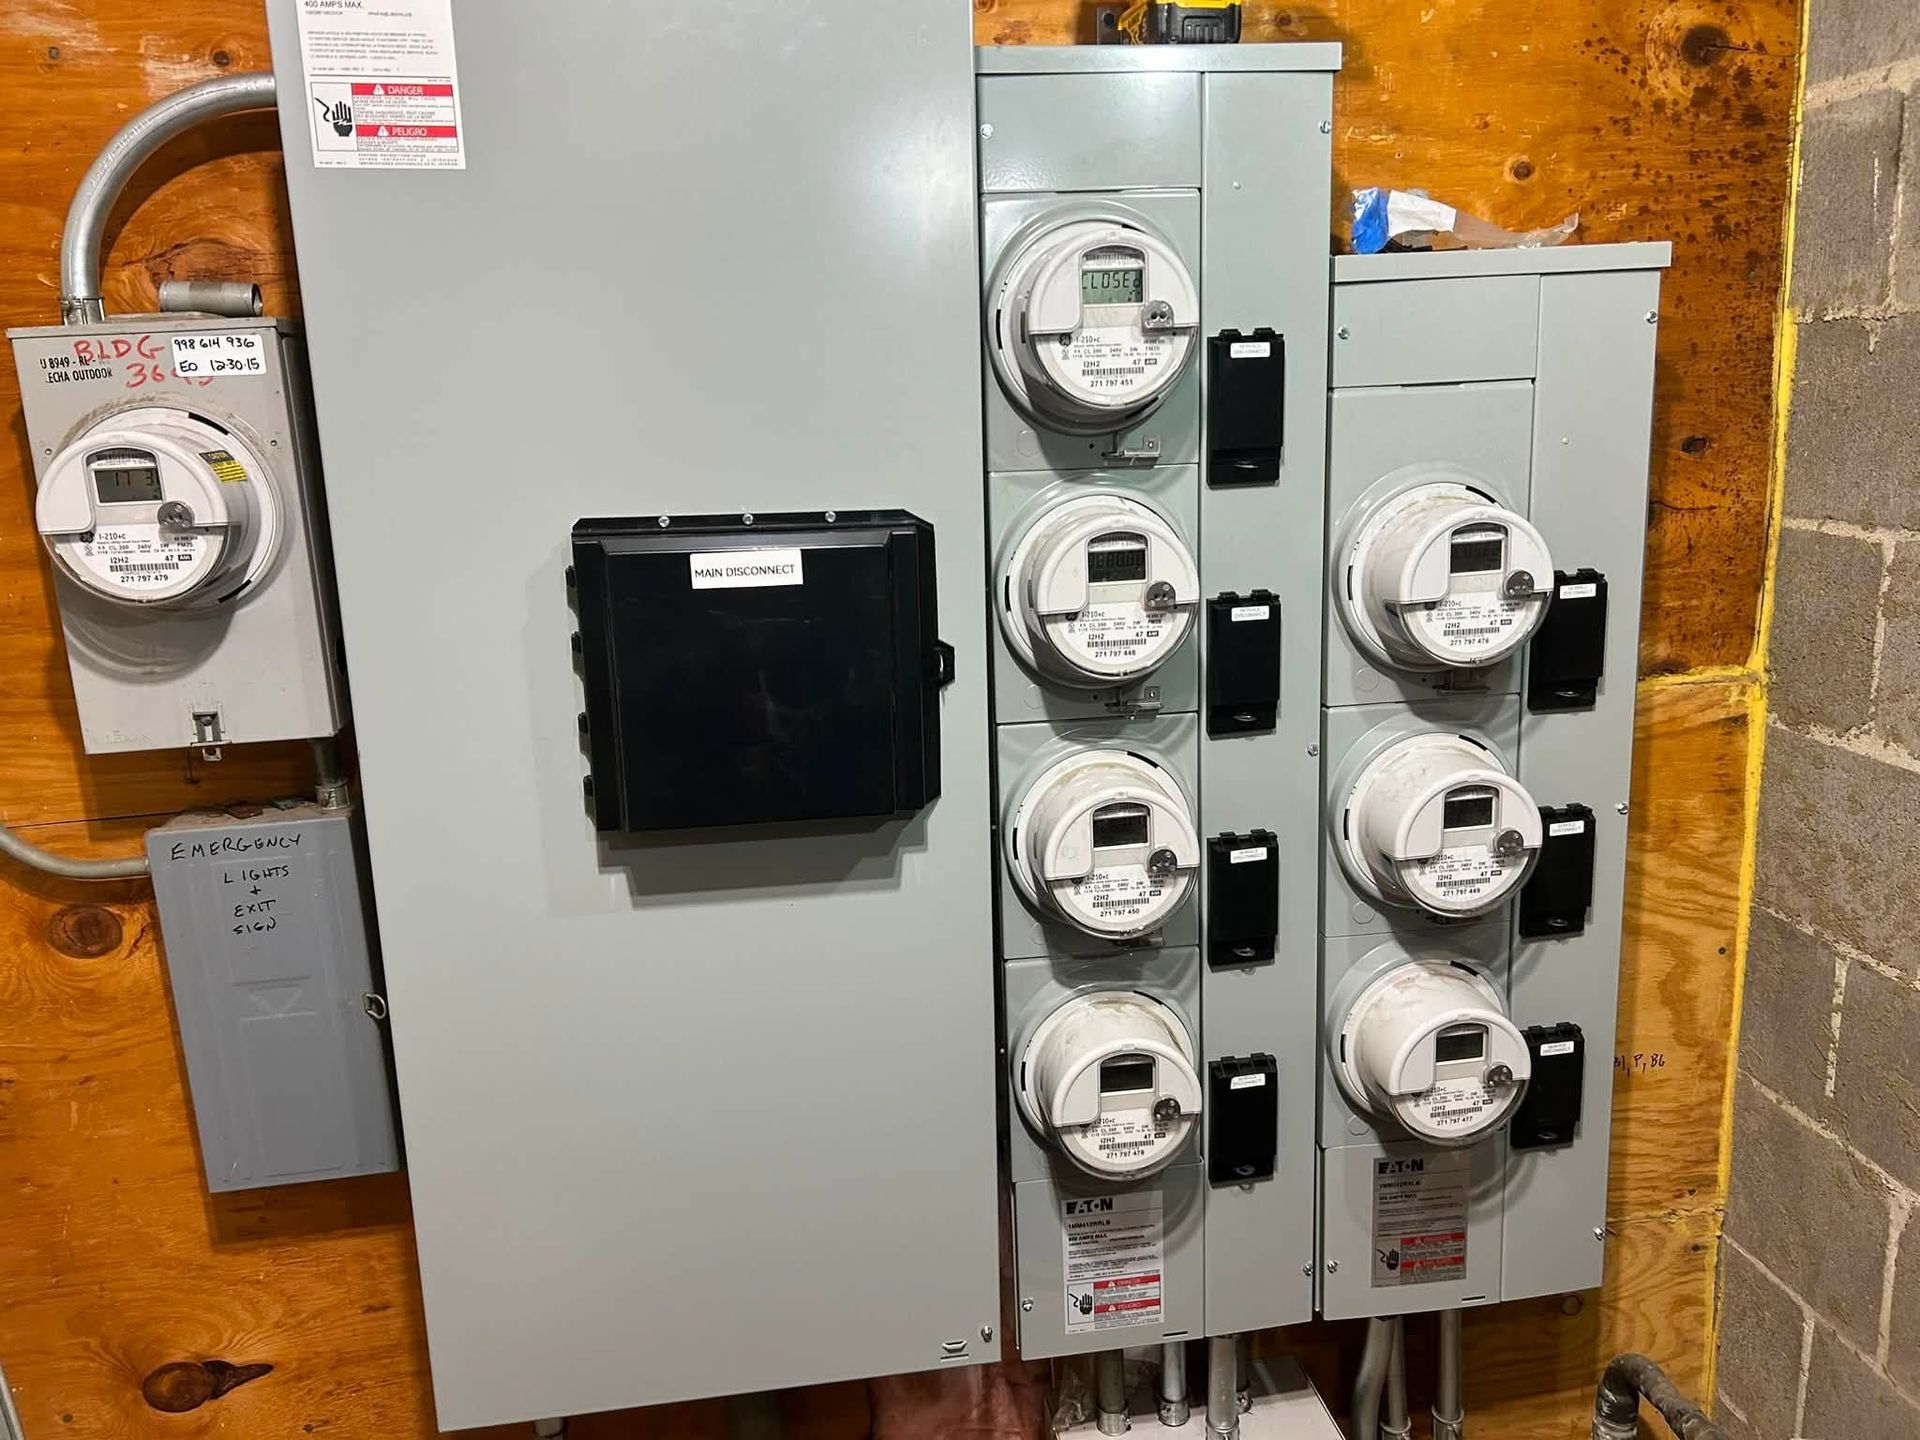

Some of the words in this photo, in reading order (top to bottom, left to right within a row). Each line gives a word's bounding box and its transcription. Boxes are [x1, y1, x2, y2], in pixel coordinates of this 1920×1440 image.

[388, 86, 423, 95] DANGER
[392, 127, 428, 137] PELIGRO
[74, 335, 165, 361] BLDG
[174, 338, 195, 351] 998
[199, 337, 221, 348] 614
[226, 336, 255, 348] 936
[50, 357, 69, 369] 8949
[73, 367, 113, 381] OUTDOOR
[1090, 380, 1102, 388] 271
[165, 554, 175, 562] 47
[154, 574, 169, 582] 479
[694, 567, 713, 579] MAIN
[716, 564, 786, 577] DISCONNECT
[171, 833, 301, 860] EMERGENCY
[234, 899, 277, 917] EXIT
[232, 917, 277, 935] SIGN
[1378, 1159, 1424, 1175] EATON
[1066, 1197, 1113, 1215] EATON
